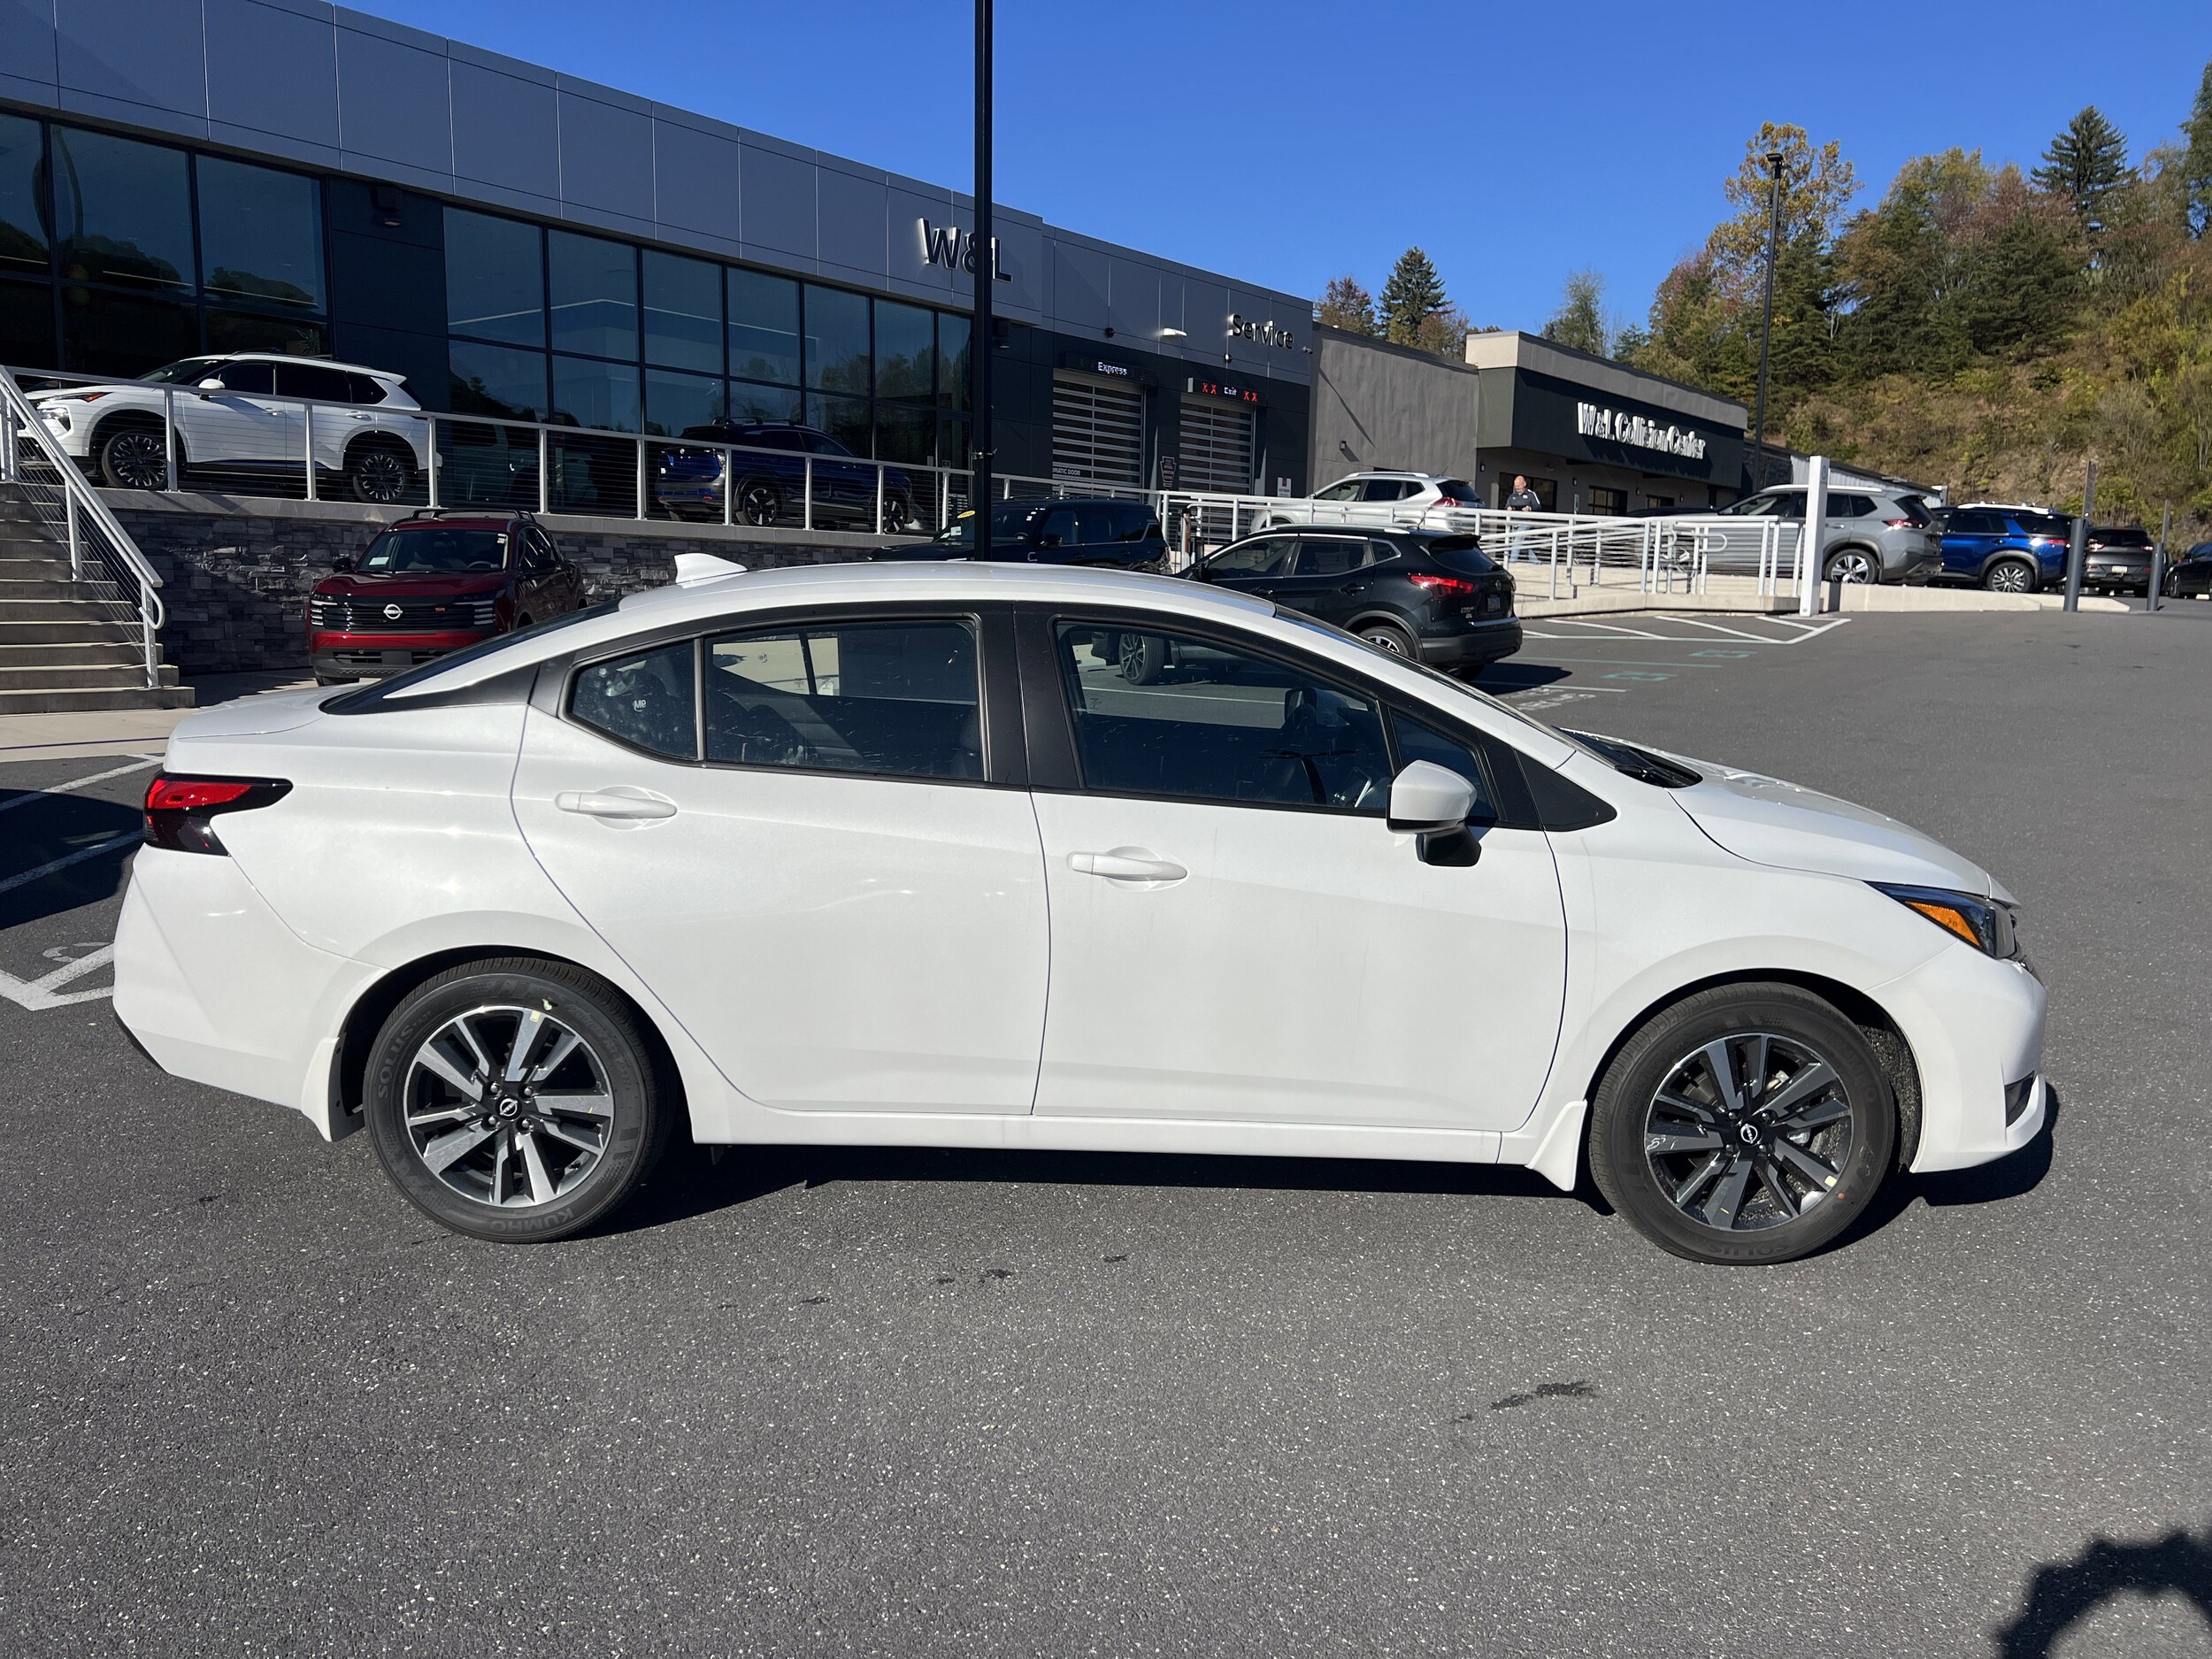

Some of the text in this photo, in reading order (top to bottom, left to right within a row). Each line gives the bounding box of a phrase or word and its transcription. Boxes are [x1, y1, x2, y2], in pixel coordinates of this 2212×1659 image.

[1227, 314, 1294, 349] Service
[1098, 362, 1127, 375] Express
[1578, 402, 1706, 459] W&L Collision Center
[379, 1025, 413, 1098] SOLUS
[489, 1207, 575, 1233] KUMHO
